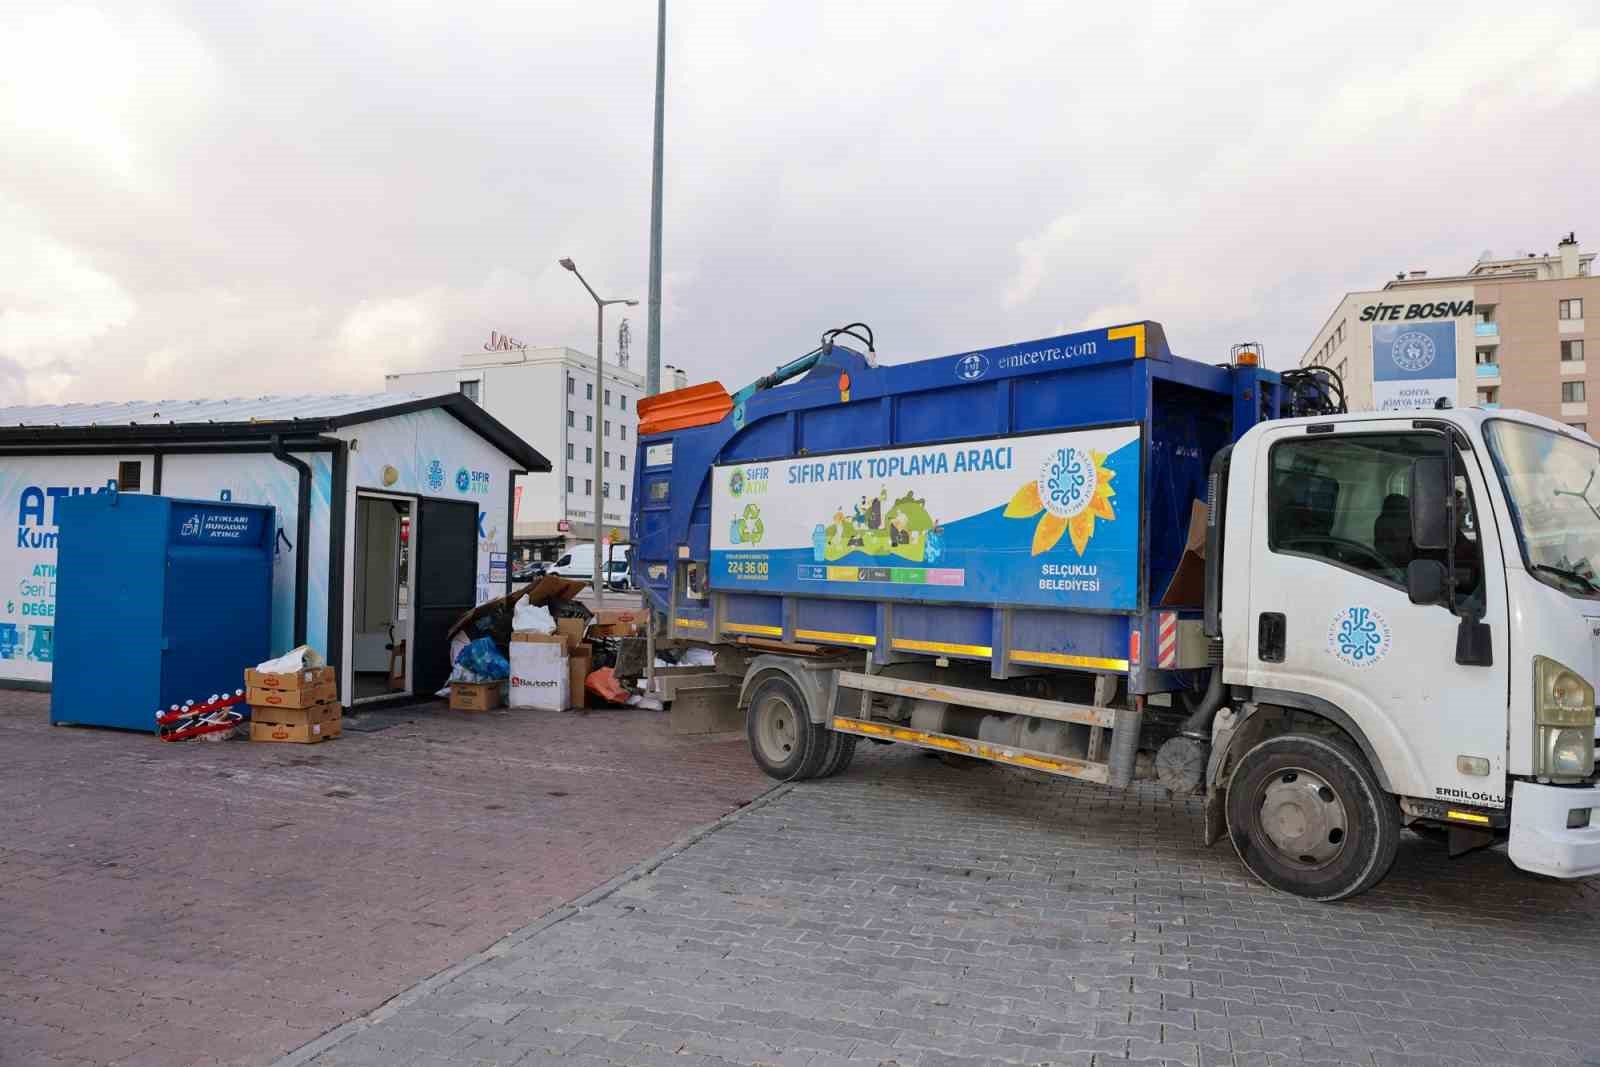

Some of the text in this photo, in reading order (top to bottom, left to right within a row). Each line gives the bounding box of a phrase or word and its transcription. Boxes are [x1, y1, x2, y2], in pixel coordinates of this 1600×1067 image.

[1360, 300, 1474, 322] SİTE BOSNA
[998, 341, 1097, 369] emicevre.com
[788, 446, 1013, 484] SIFIR ATIK TOPLAMA ARACI
[471, 471, 489, 482] SIFIR
[747, 467, 768, 480] SIFIR
[17, 527, 58, 548] Kum
[727, 561, 769, 573] 224 36 00
[1041, 564, 1097, 578] SELÇUKLU
[1039, 578, 1100, 592] BELEDİYESİ
[22, 600, 55, 616] DEĞE
[1435, 787, 1505, 803] ERDİLOĞLU
